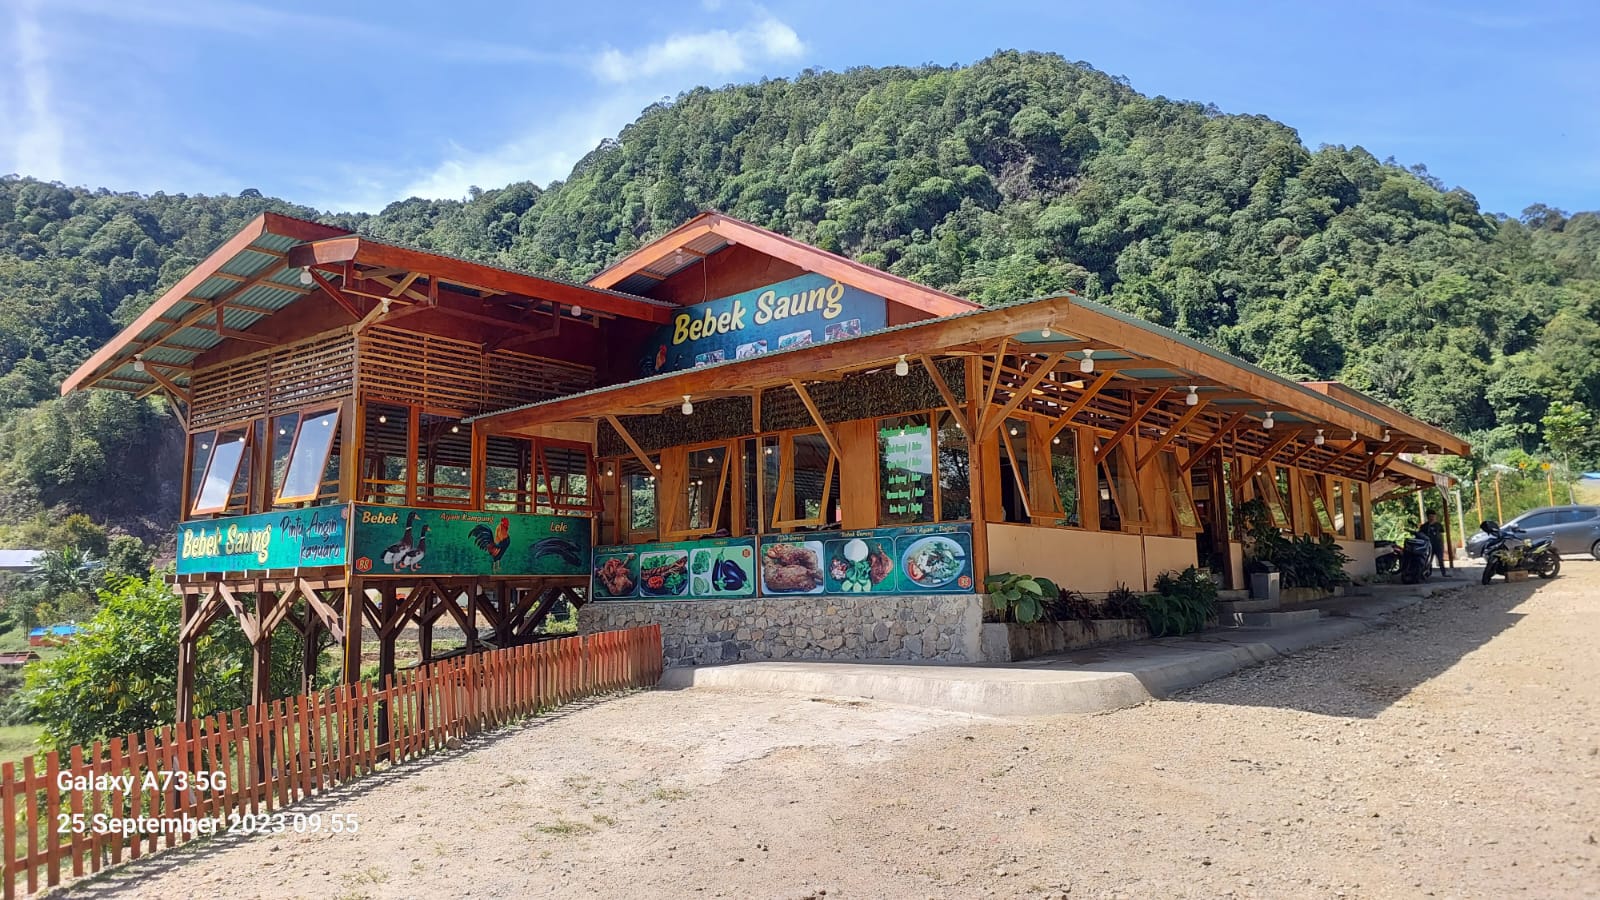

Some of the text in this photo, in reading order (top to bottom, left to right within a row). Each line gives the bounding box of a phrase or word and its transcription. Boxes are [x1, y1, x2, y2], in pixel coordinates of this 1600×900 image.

[671, 280, 845, 346] Bebek Saung
[361, 511, 399, 525] Bebek
[462, 513, 495, 525] Kampung
[549, 521, 568, 533] Lele
[181, 523, 272, 565] Bebek Saung
